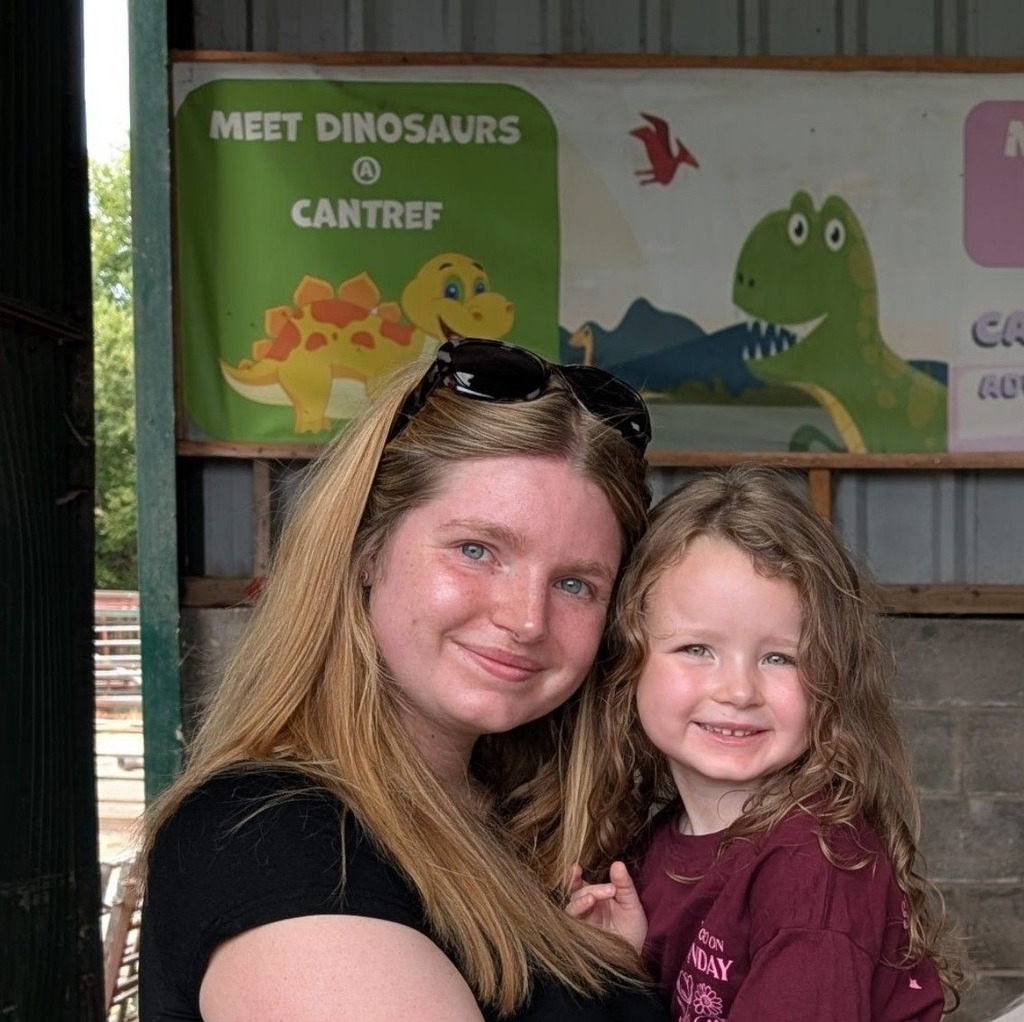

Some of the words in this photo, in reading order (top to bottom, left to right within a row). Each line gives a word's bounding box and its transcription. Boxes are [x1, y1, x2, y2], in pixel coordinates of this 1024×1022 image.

[209, 110, 302, 142] MEET
[315, 112, 522, 144] DINOSAURS
[290, 198, 443, 230] CANTREF
[687, 941, 734, 982] NDAY
